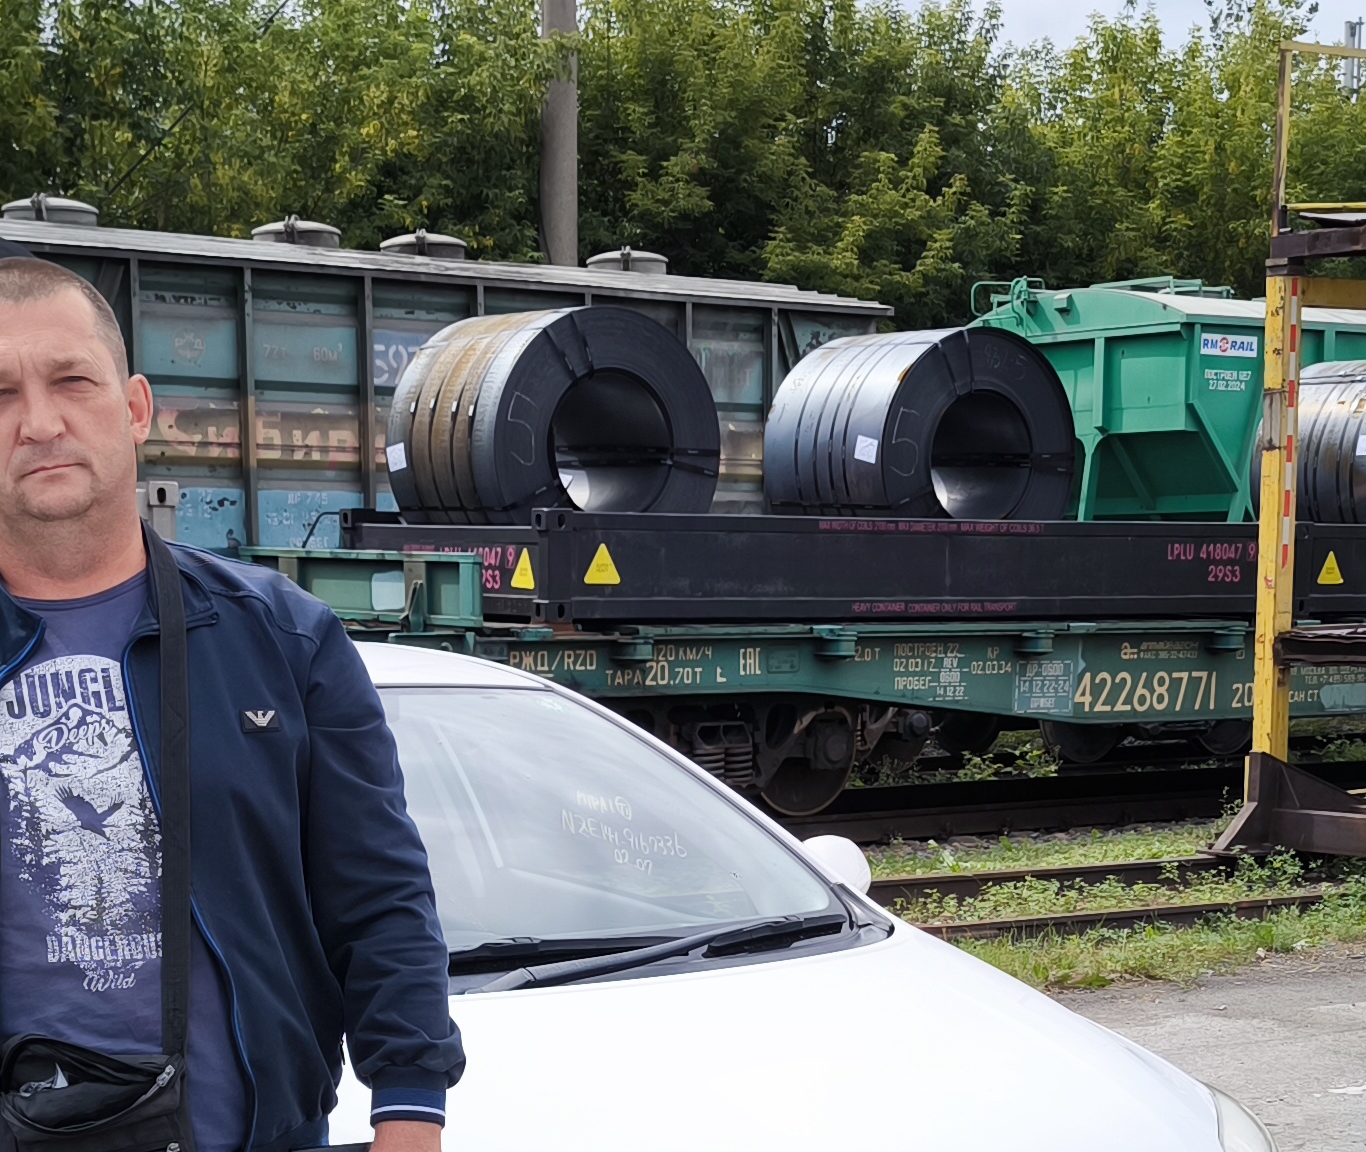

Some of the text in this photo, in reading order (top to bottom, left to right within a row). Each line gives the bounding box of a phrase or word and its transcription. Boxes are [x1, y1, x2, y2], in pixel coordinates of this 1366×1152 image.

[1202, 338, 1255, 352] RM RAIL
[1167, 543, 1194, 560] LPLU
[1200, 543, 1242, 560] 418047
[1208, 565, 1241, 582] 29S3
[852, 601, 871, 612] HEAVY
[872, 601, 905, 613] CONTAINER
[908, 602, 940, 613] CONTAINER
[984, 602, 1017, 613] TRANSPORT
[893, 642, 943, 657] ПОСТРОЕН
[605, 668, 643, 687] ТАРА
[894, 677, 931, 690] ПРОБЕГ
[4, 667, 127, 720] JUNGL
[1073, 670, 1217, 714] 42268771
